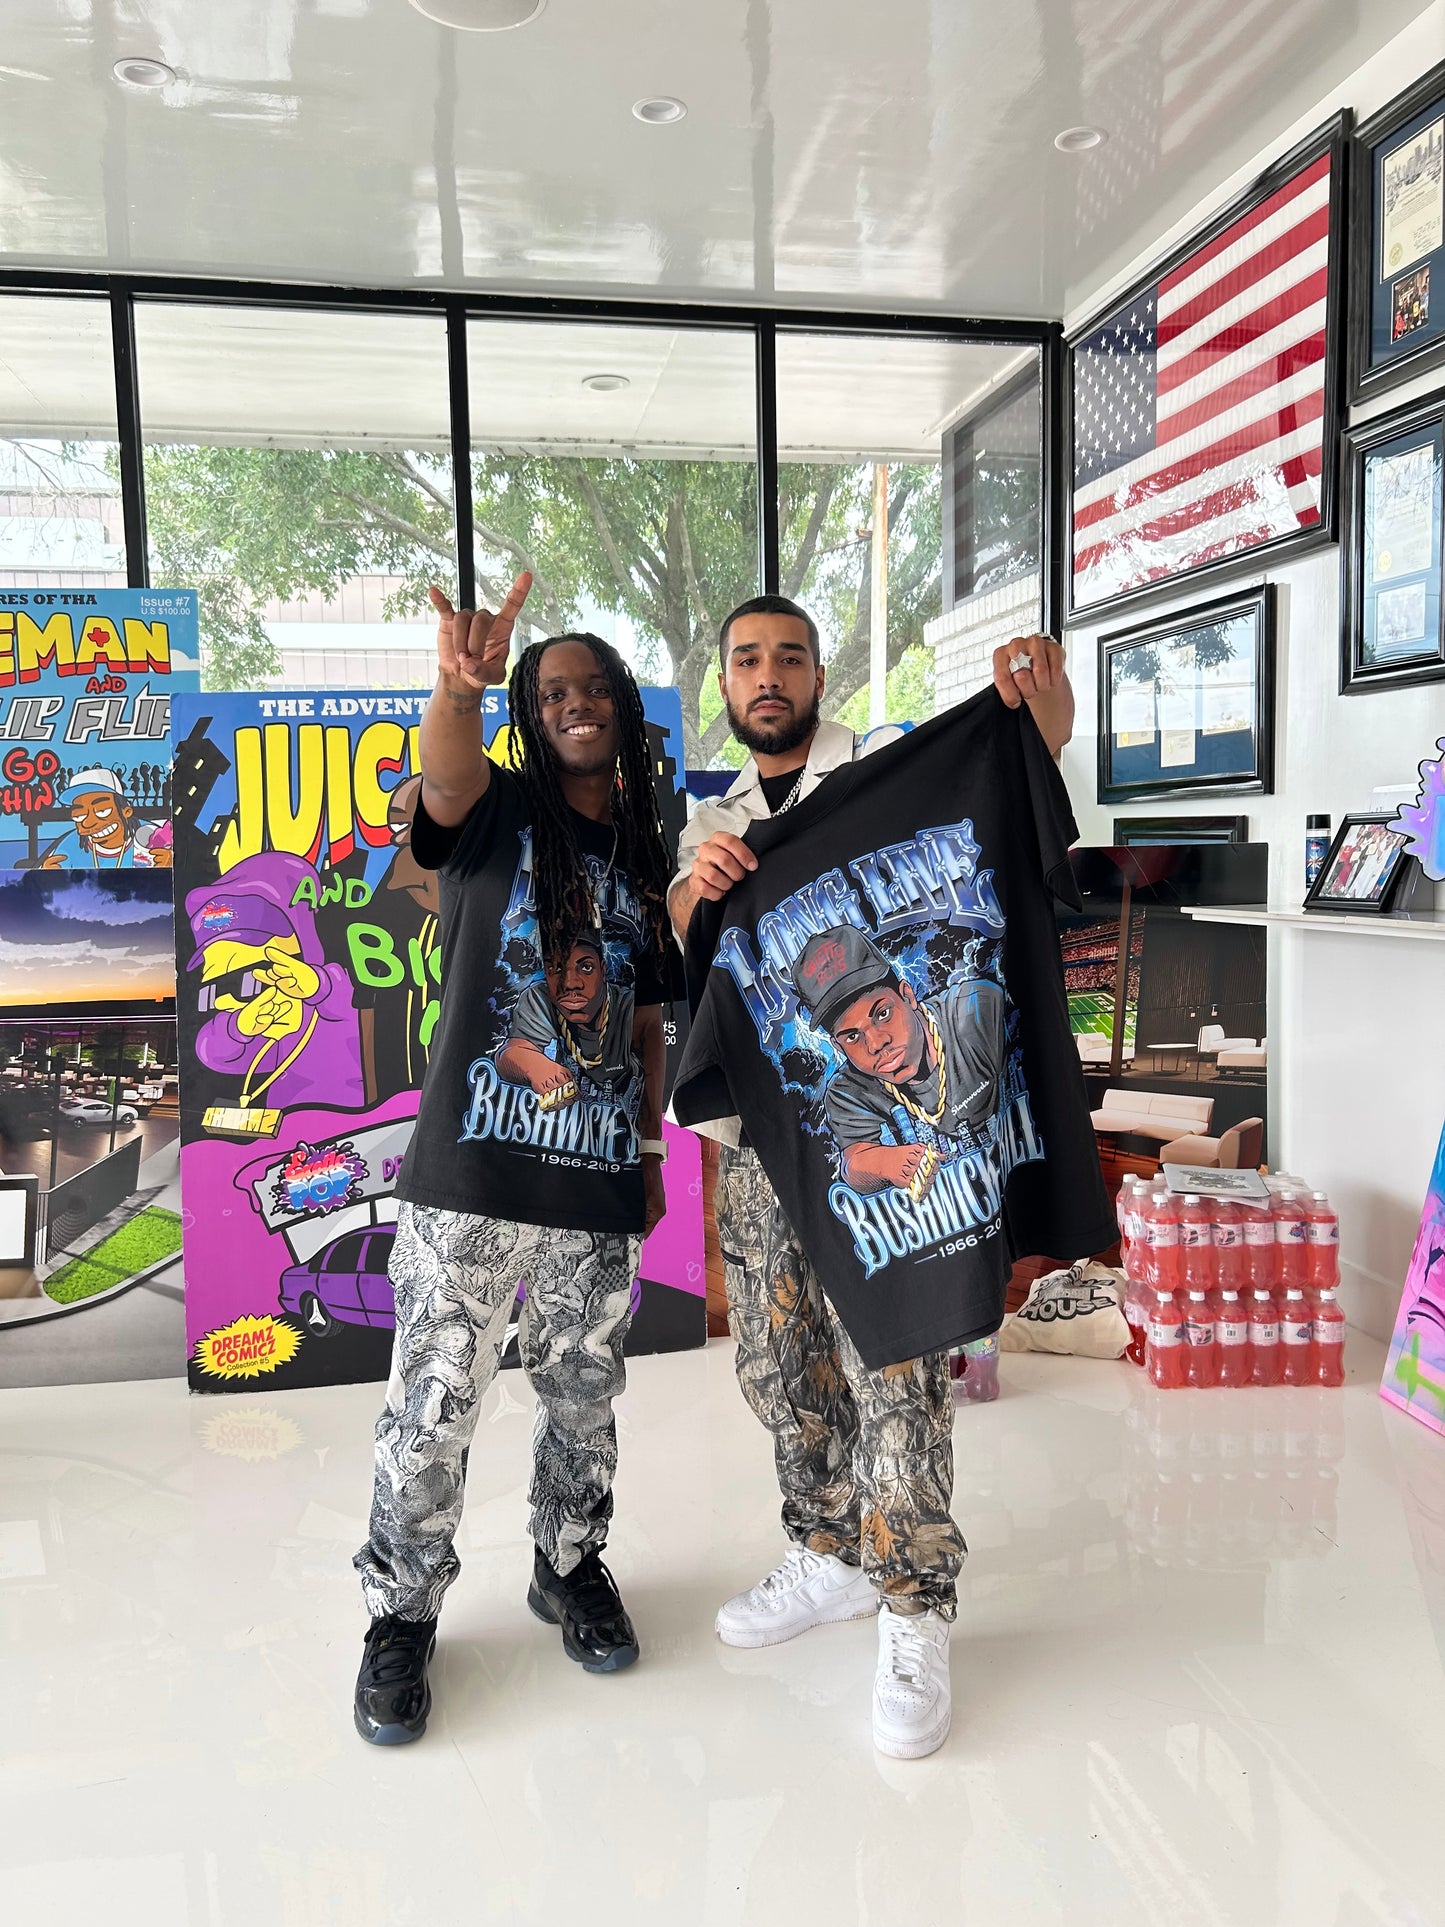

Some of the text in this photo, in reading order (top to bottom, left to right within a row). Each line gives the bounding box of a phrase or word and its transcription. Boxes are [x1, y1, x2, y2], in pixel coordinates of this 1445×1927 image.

[33, 594, 58, 605] OF
[61, 594, 98, 605] THA
[140, 596, 191, 607] Issue #7
[158, 607, 191, 616] $100.00
[86, 674, 127, 694] AND
[259, 699, 315, 717] THE
[321, 696, 499, 717] ADVENTS
[2, 747, 61, 784] GO
[0, 779, 56, 815] HIN
[290, 872, 372, 909] AND
[712, 867, 871, 1050] LONG
[848, 817, 1007, 940] LIVE
[457, 1056, 626, 1165] BUSHWICK
[538, 1081, 575, 1111] WIC
[540, 1153, 621, 1173] 1966-2019
[287, 1167, 352, 1210] POP
[828, 1142, 1002, 1280] BUSHWICK
[938, 1217, 1002, 1258] 1966-20
[1017, 1296, 1117, 1322] HOUSE
[212, 1324, 274, 1356] DREAMZ
[216, 1338, 276, 1367] COMICZ
[226, 1361, 259, 1371] Collection
